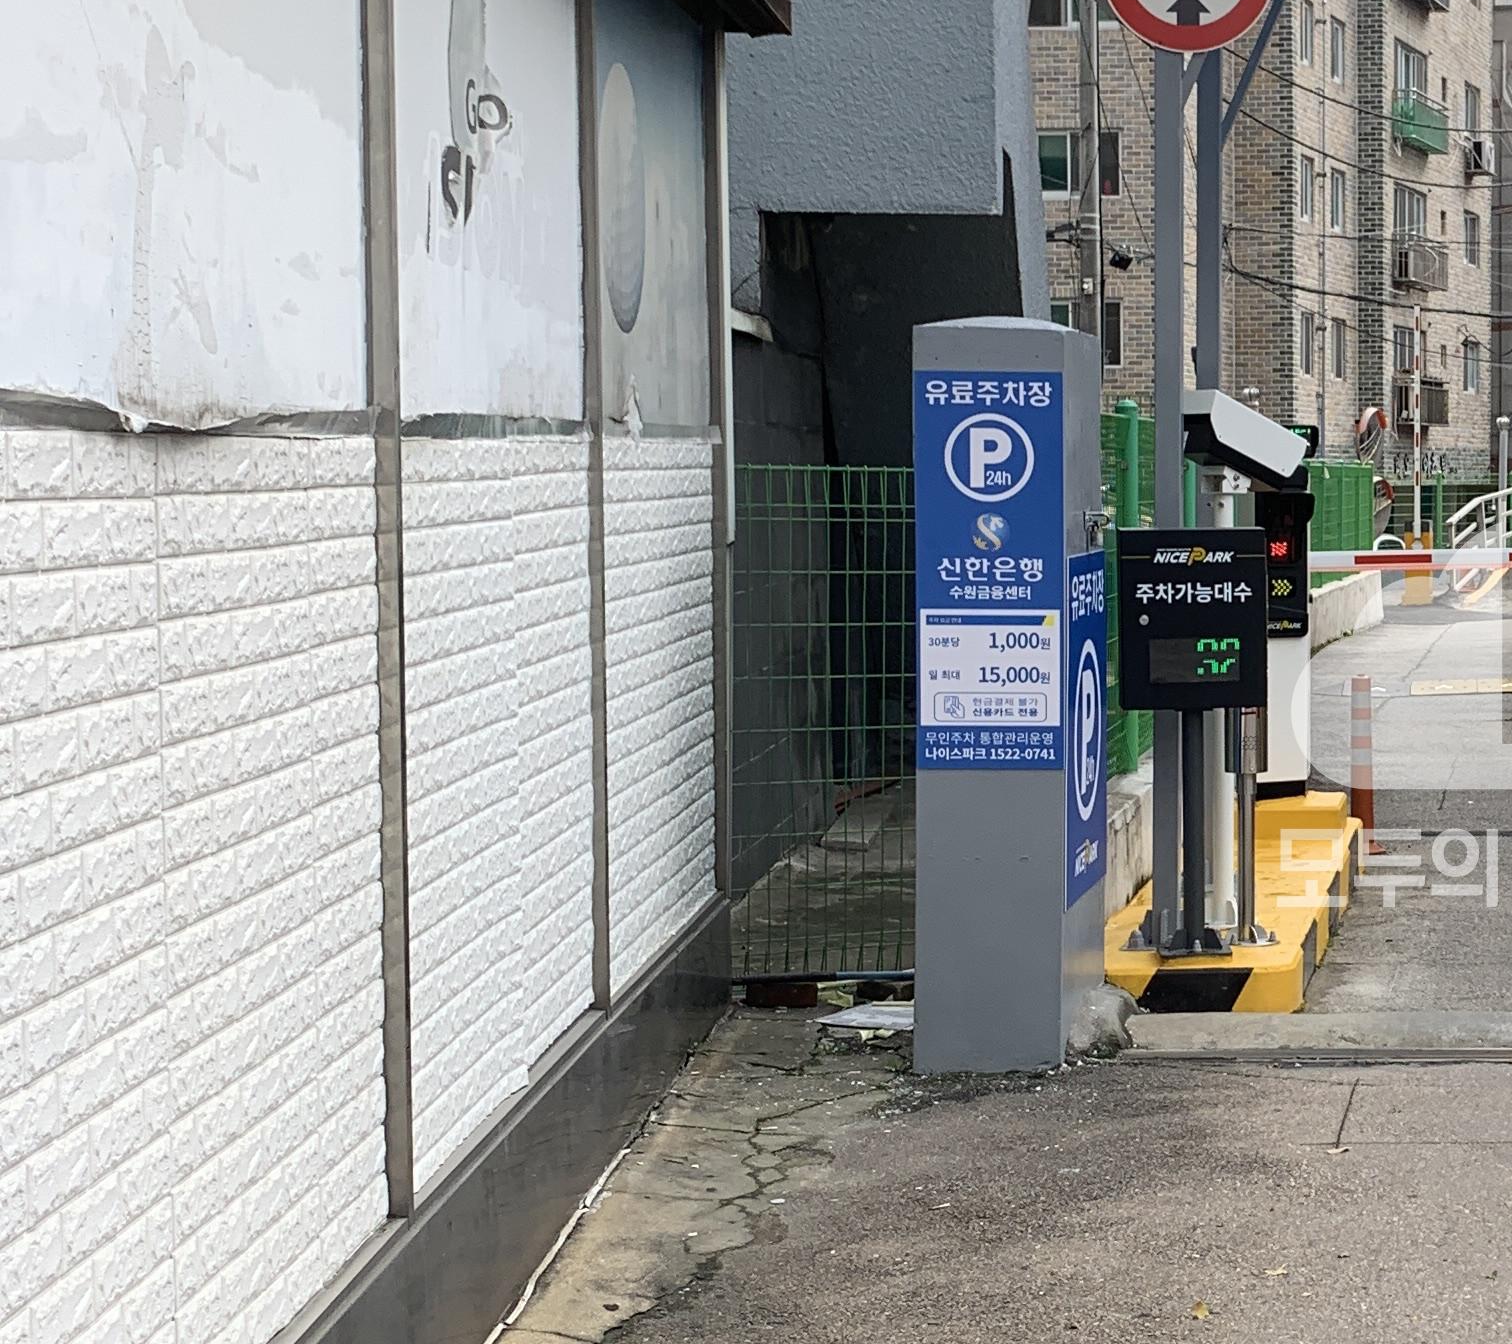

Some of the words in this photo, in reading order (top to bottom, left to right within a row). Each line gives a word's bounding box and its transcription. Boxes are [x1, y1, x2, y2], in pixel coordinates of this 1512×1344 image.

[925, 379, 1052, 407] 유료주차장
[969, 427, 1013, 489] P
[986, 470, 1012, 486] 24h
[1153, 547, 1235, 566] NICEPARK
[936, 556, 1044, 582] 신한은행
[949, 585, 1032, 601] 수원금융센터
[1071, 569, 1104, 621] 유료주차장
[1135, 582, 1253, 604] 주차가능대수
[928, 637, 960, 648] 30분당
[988, 632, 1051, 652] 1,000원
[941, 670, 961, 680] 최대
[978, 666, 1051, 687] 15,000원
[972, 697, 1014, 707] 현금결제
[1018, 697, 1039, 707] 불가
[972, 707, 1014, 717] 신용카드
[1018, 707, 1039, 717] 전용
[925, 731, 975, 746] 무인주차
[980, 731, 1054, 746] 통합관리운영
[925, 747, 987, 761] 나이스파크
[990, 747, 1056, 760] 1522-0741
